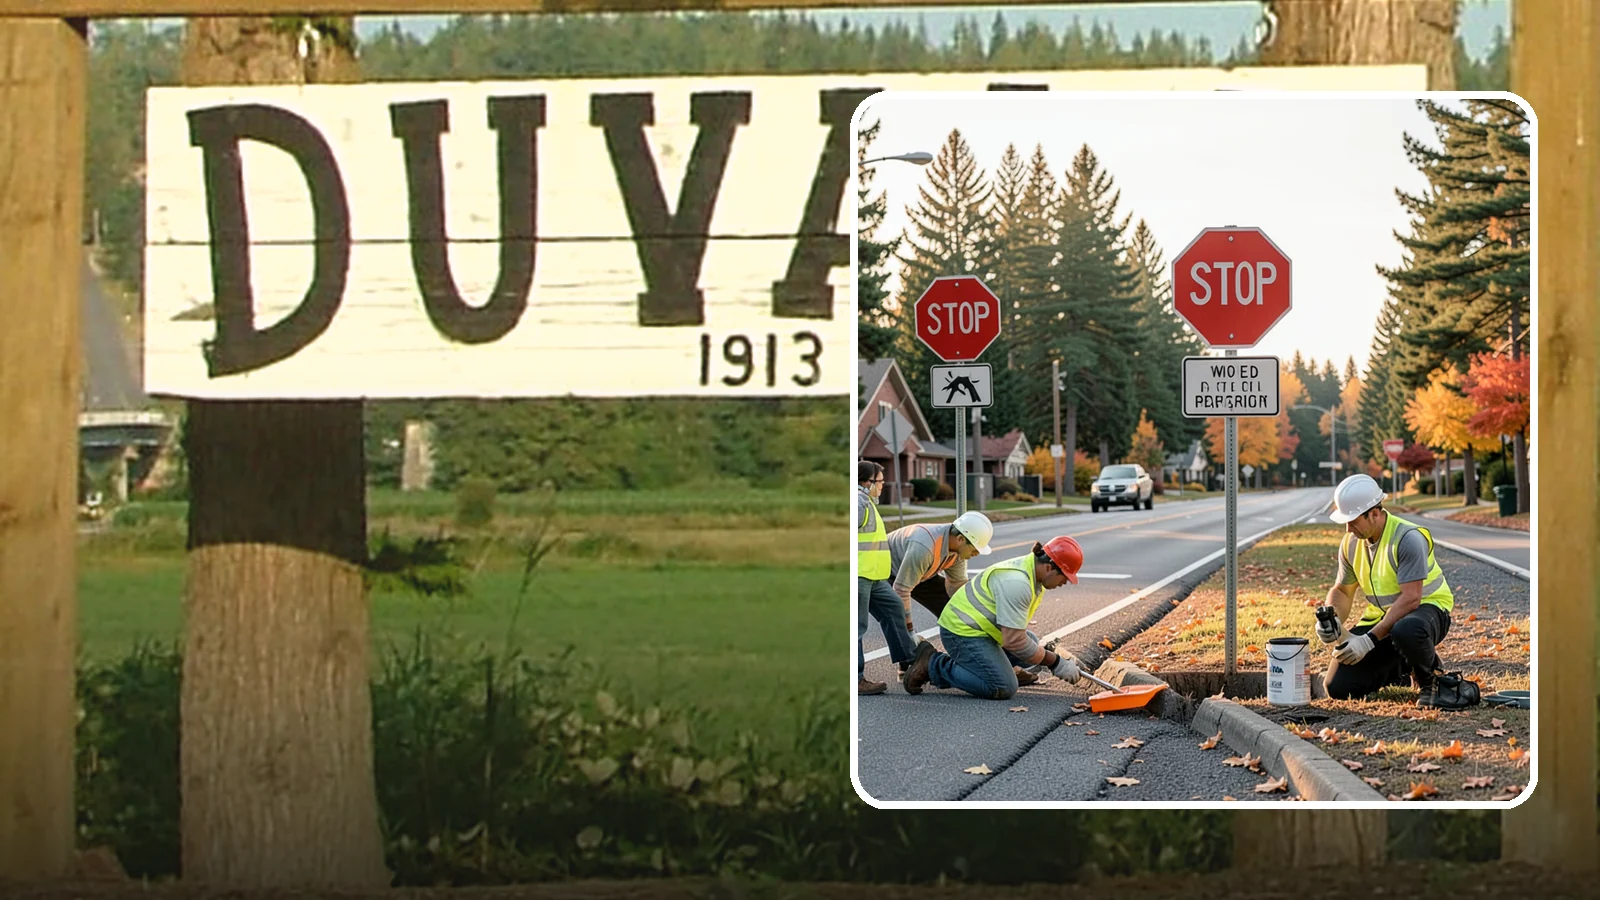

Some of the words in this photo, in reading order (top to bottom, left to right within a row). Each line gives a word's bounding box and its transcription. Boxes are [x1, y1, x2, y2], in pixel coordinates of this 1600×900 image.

[186, 84, 1242, 378] DUVA
[1190, 261, 1277, 306] STOP
[927, 301, 990, 335] STOP
[700, 331, 823, 387] 1913
